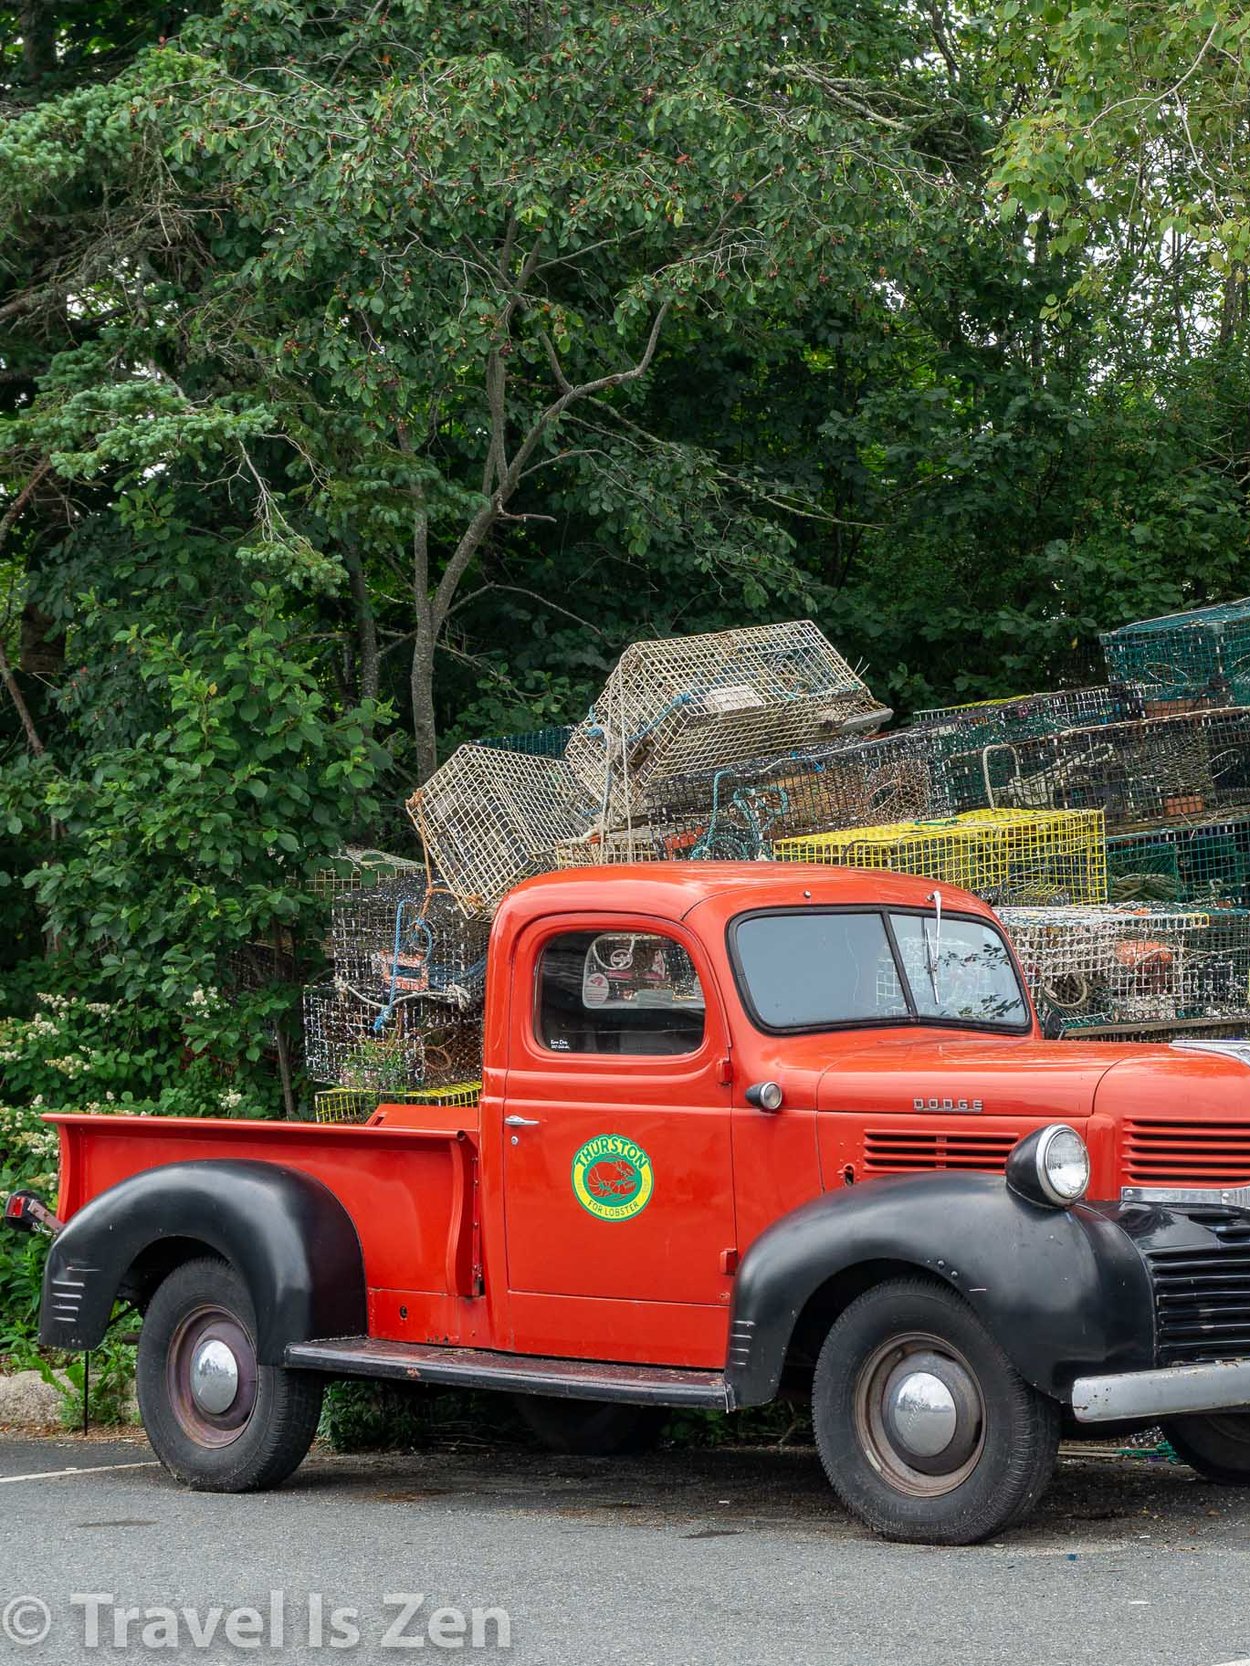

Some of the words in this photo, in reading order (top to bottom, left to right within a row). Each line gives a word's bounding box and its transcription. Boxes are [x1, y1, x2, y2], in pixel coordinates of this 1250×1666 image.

[913, 1098, 983, 1111] DODGE
[575, 1136, 649, 1169] THURSTON
[587, 1200, 603, 1213] FOR
[604, 1202, 640, 1218] LOBSTER
